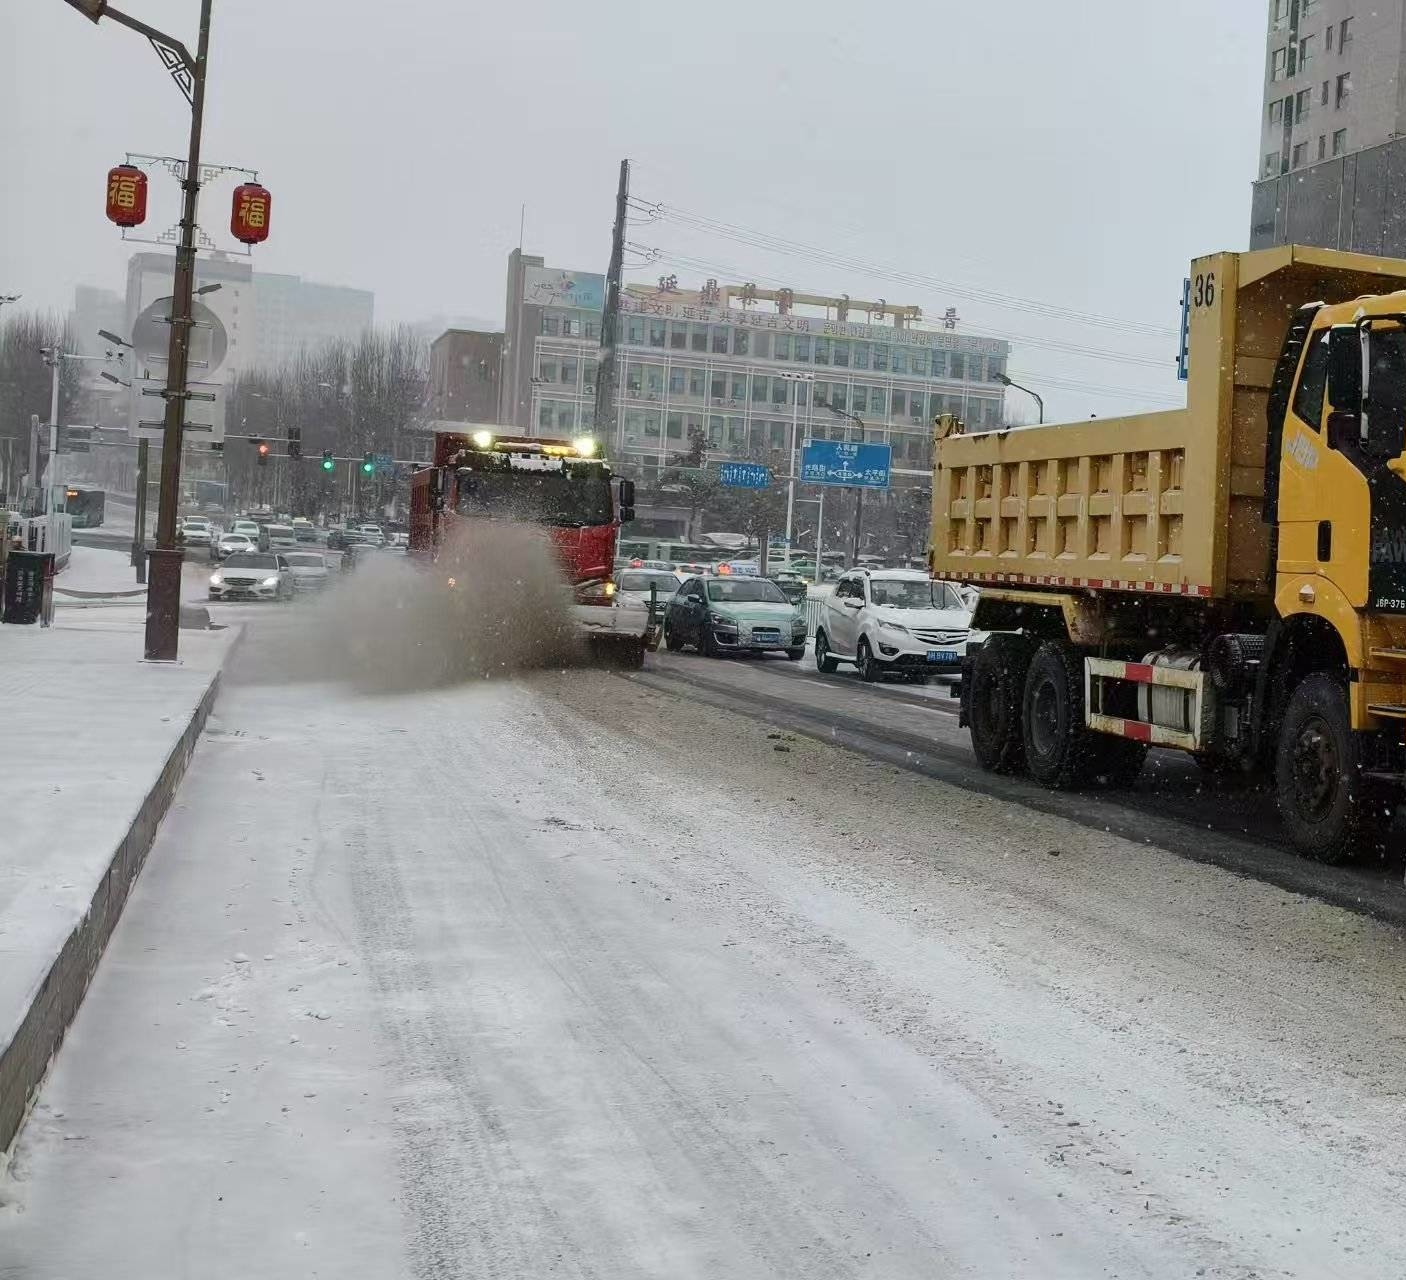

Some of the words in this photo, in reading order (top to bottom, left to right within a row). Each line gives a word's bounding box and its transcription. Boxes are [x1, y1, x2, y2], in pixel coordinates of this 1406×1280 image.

[108, 174, 138, 209] 福
[238, 194, 266, 229] 福
[1194, 272, 1215, 308] 36
